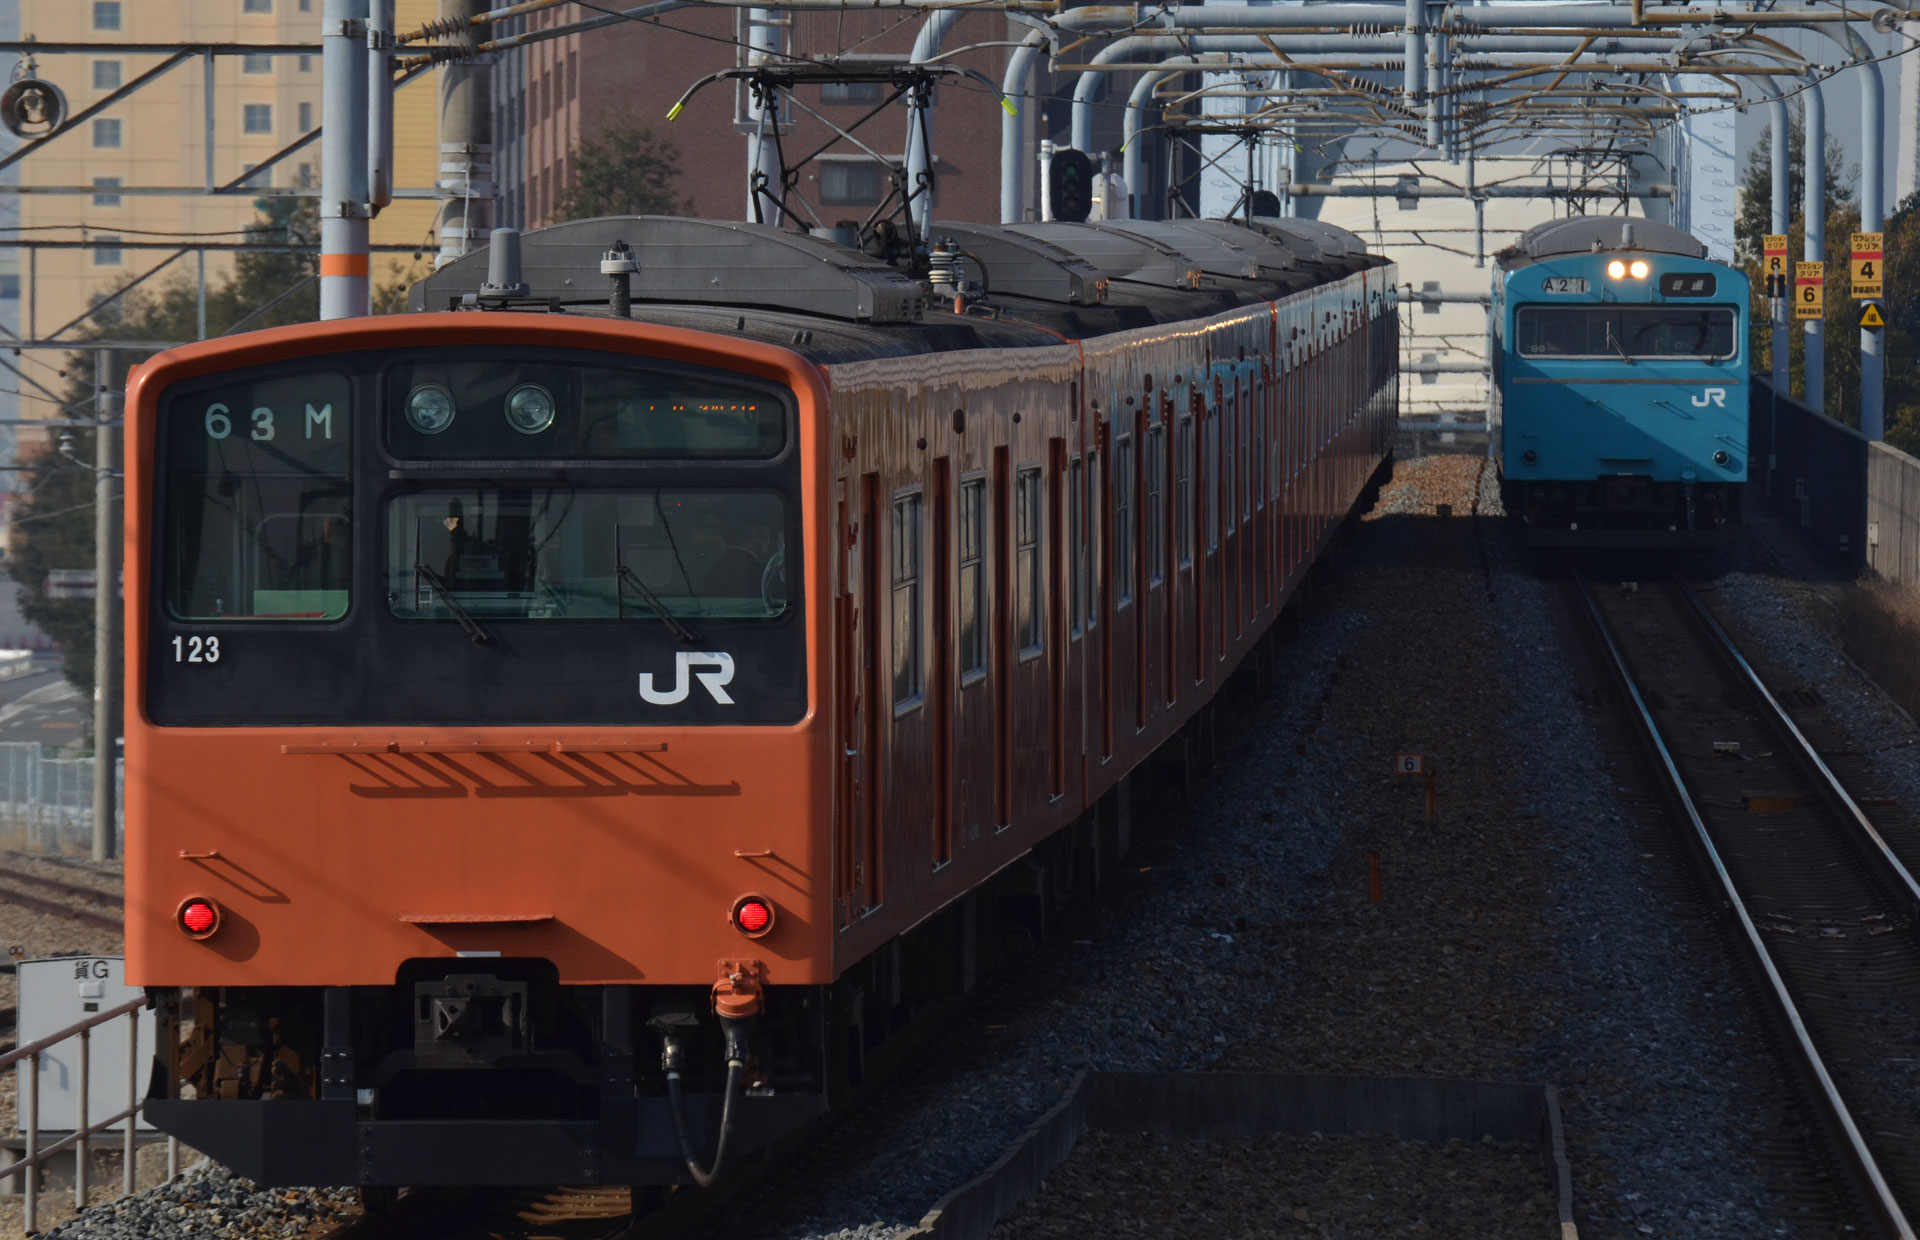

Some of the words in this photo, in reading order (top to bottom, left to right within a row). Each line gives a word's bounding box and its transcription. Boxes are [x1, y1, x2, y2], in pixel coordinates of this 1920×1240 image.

[1770, 257, 1780, 271] 8
[1861, 262, 1874, 279] 4
[1803, 287, 1815, 303] 6
[1691, 388, 1726, 407] JR
[172, 635, 220, 663] 123
[639, 652, 735, 705] JR
[1404, 756, 1414, 771] 6
